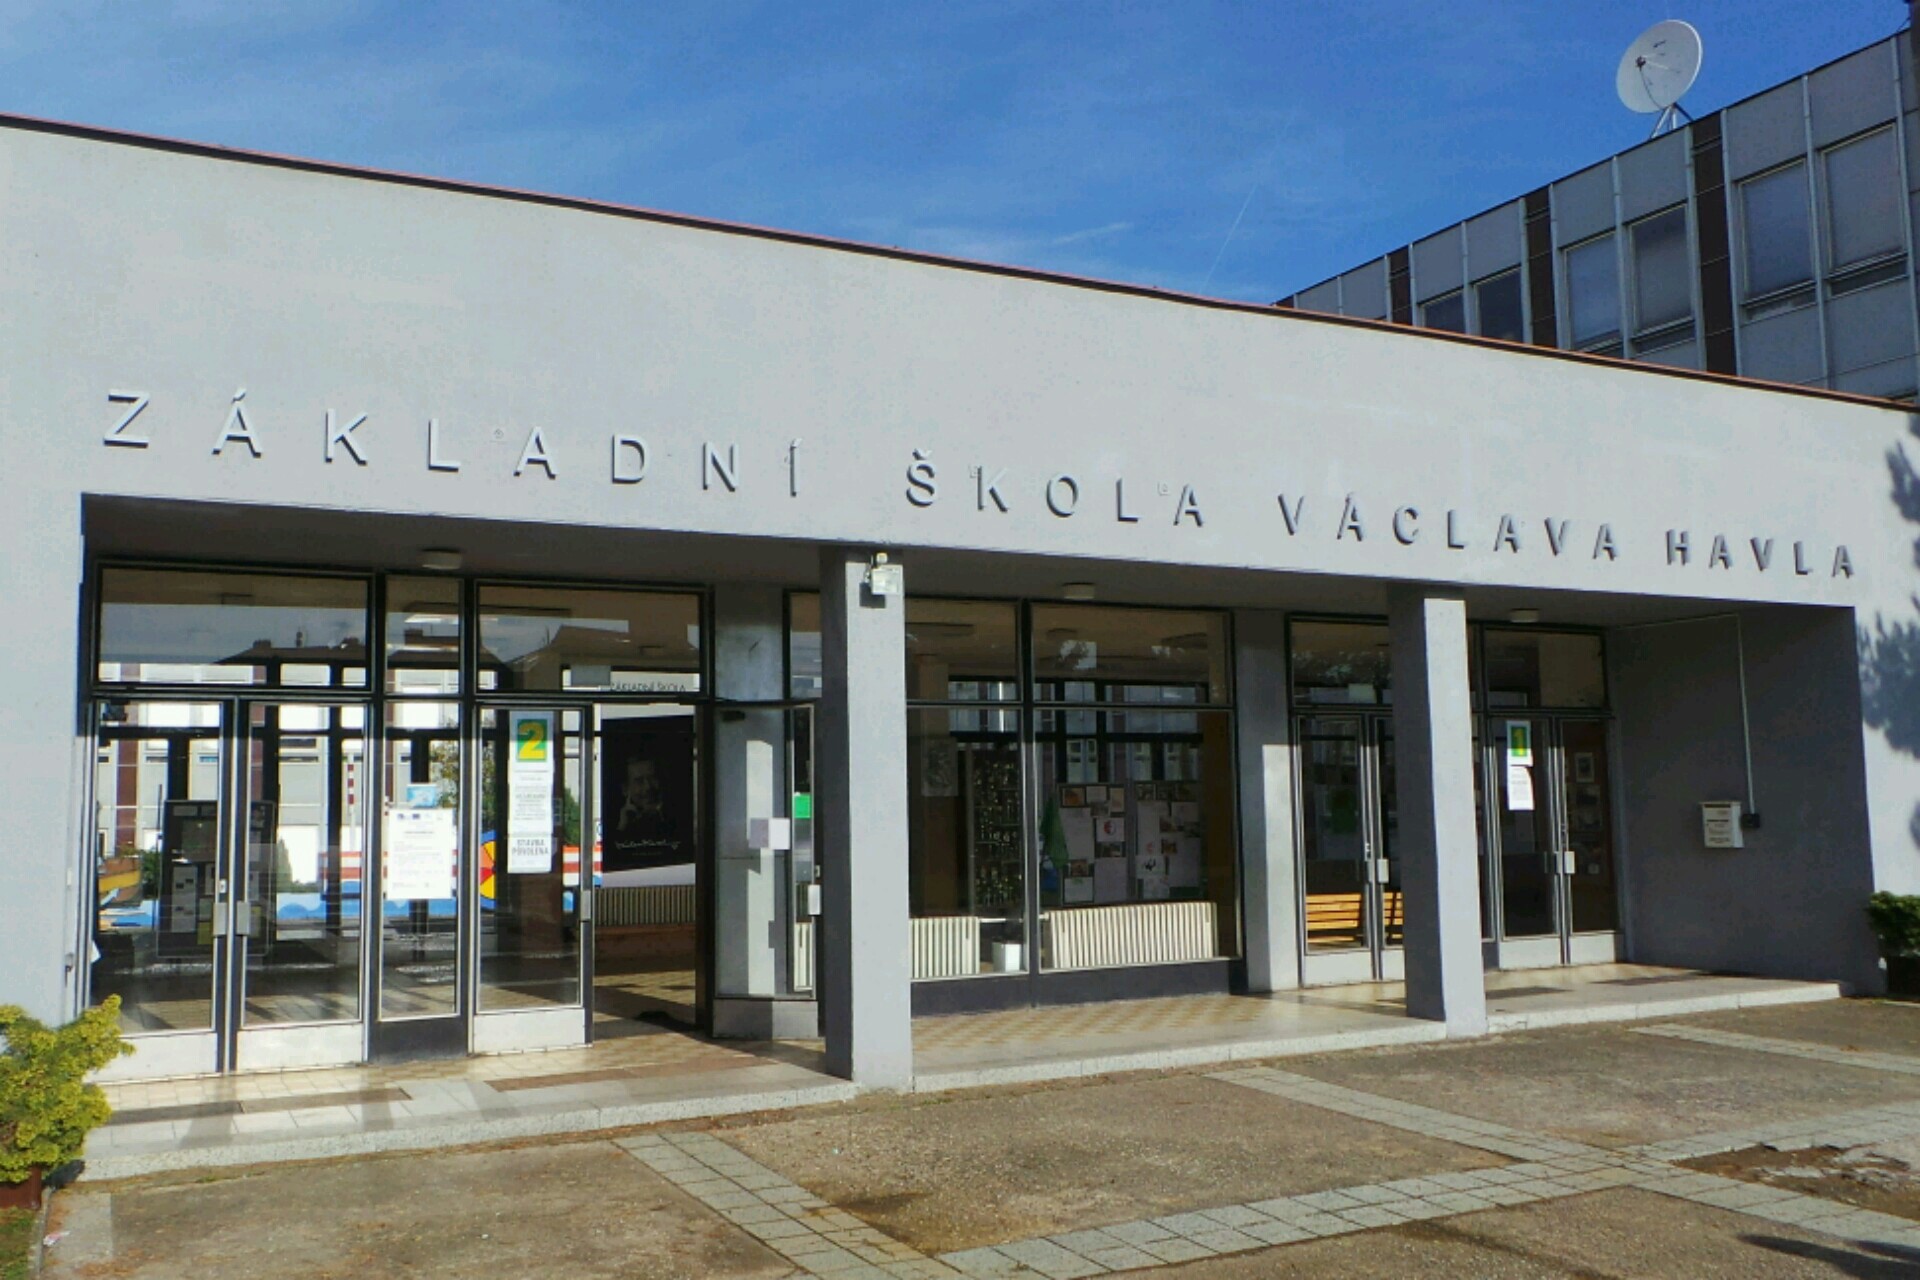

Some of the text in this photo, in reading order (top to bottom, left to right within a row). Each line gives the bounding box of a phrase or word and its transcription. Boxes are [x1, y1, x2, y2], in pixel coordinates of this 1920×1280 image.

[103, 388, 801, 497] ZÁKLADNÍ
[905, 448, 1206, 528] ŠKOLA
[1665, 528, 1855, 579] HAVLA
[518, 721, 546, 759] 2
